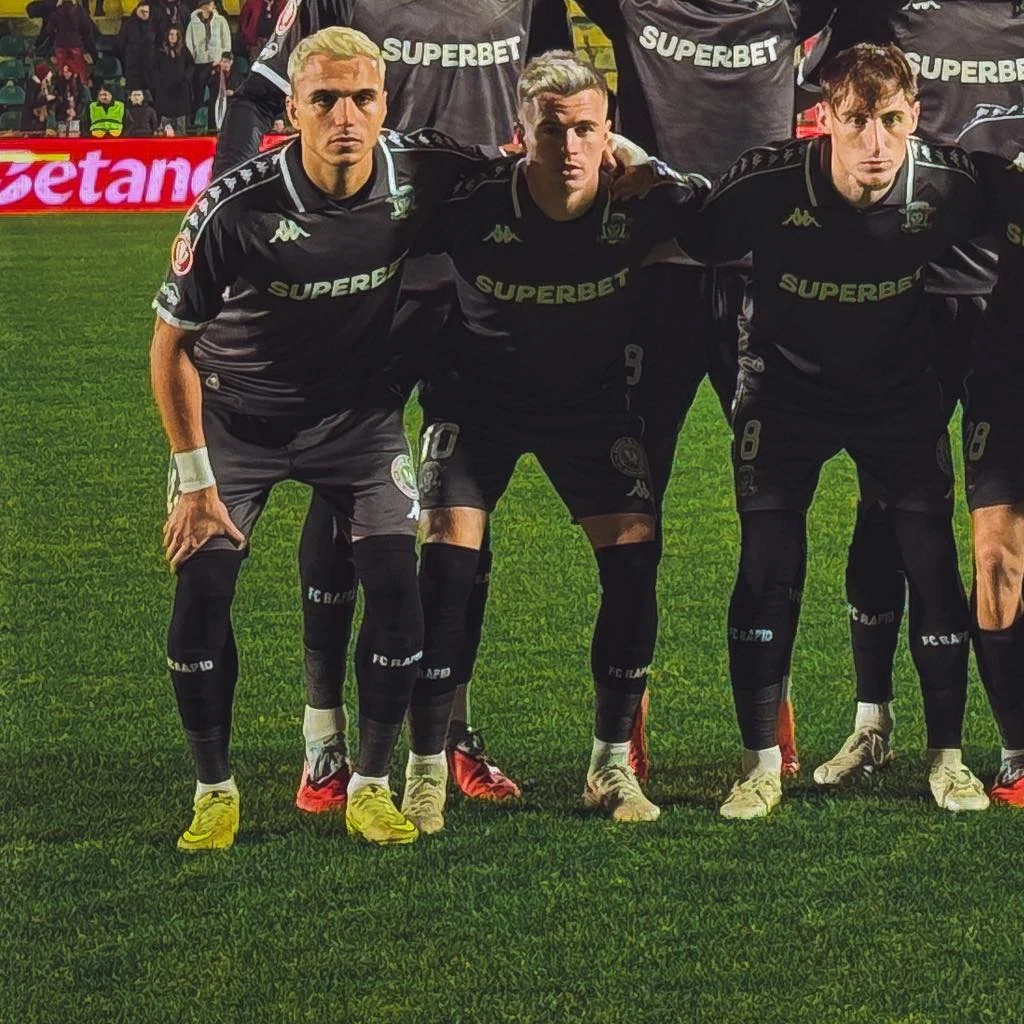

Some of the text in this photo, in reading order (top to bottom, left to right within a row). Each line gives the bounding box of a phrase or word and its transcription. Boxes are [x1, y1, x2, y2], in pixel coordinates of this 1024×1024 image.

[381, 36, 521, 68] SUPERBET
[639, 25, 779, 69] SUPERBET
[475, 268, 629, 304] SUPERBET
[420, 422, 460, 463] 10
[741, 420, 761, 460] 8
